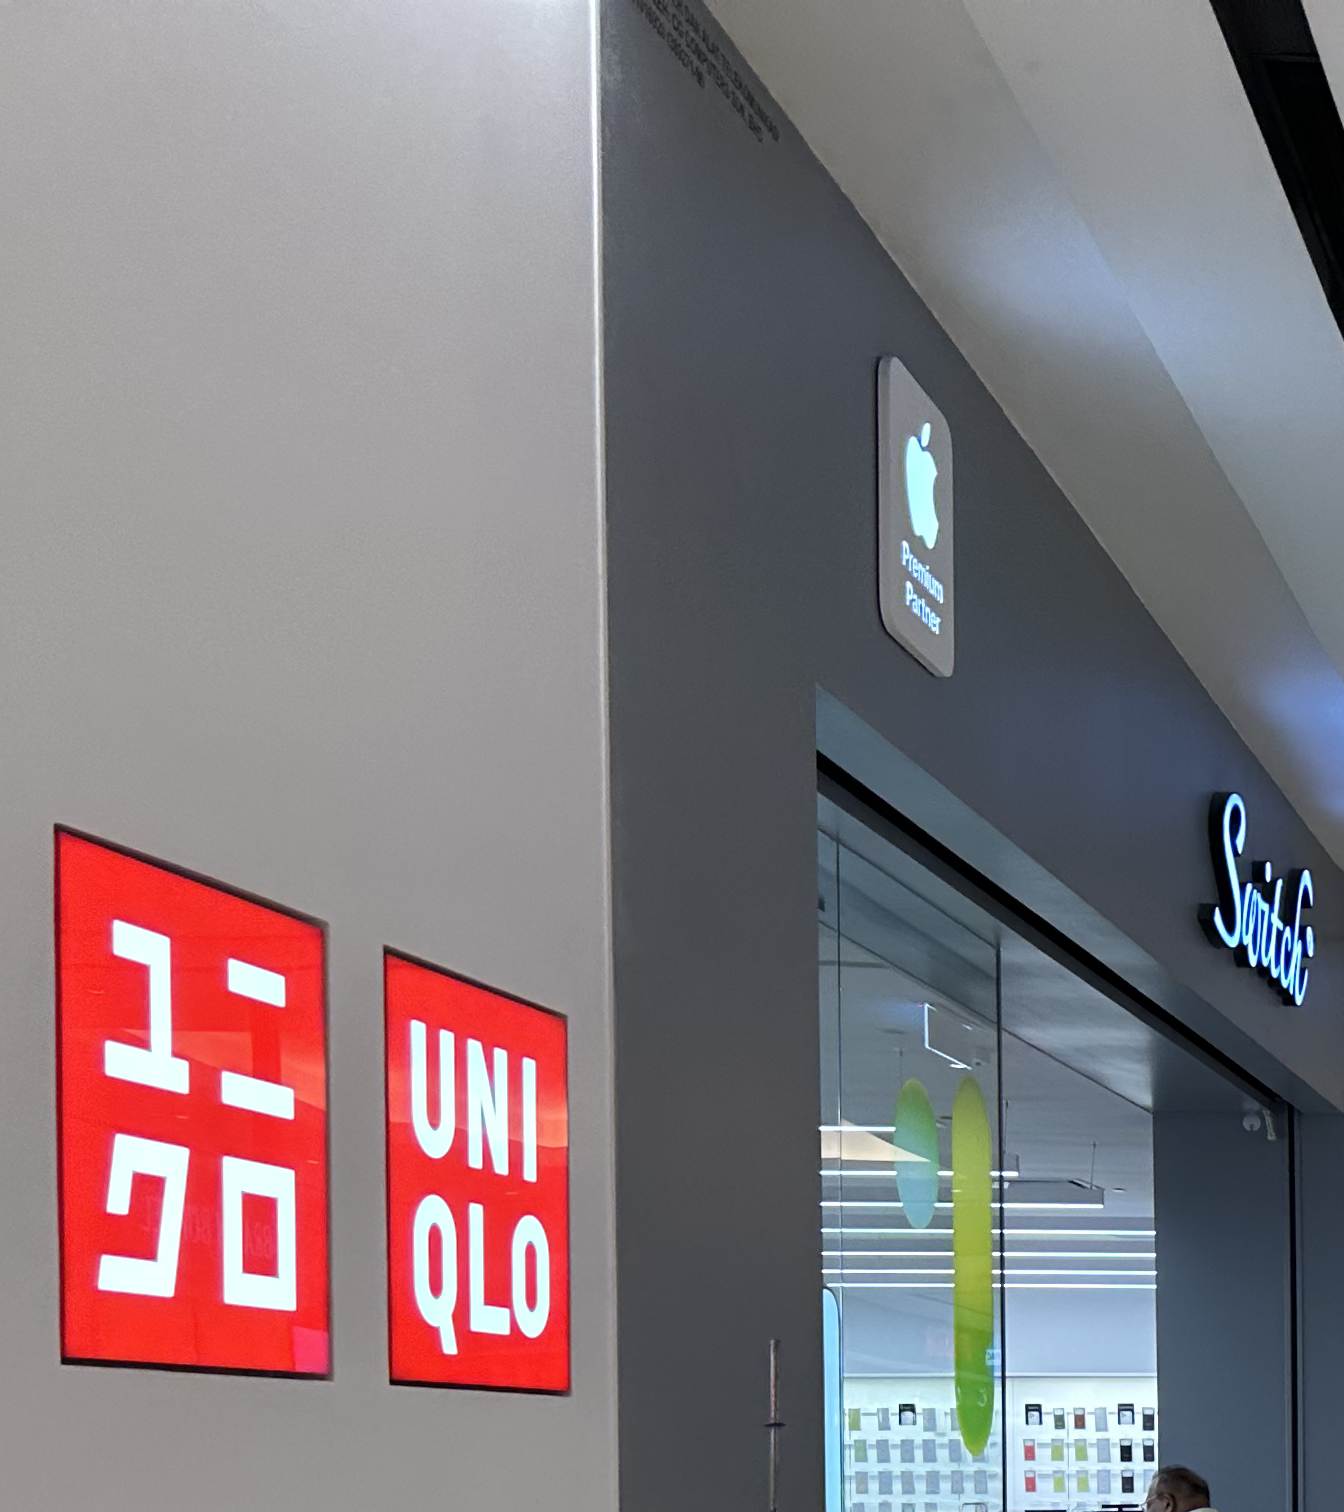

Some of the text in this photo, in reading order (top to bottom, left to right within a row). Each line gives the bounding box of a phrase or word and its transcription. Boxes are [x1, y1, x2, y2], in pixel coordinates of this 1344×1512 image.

[901, 539, 944, 605] Premium
[905, 580, 942, 635] Partner
[1213, 791, 1316, 1007] Switch
[409, 1018, 538, 1183] UNI
[412, 1193, 551, 1355] QLO
